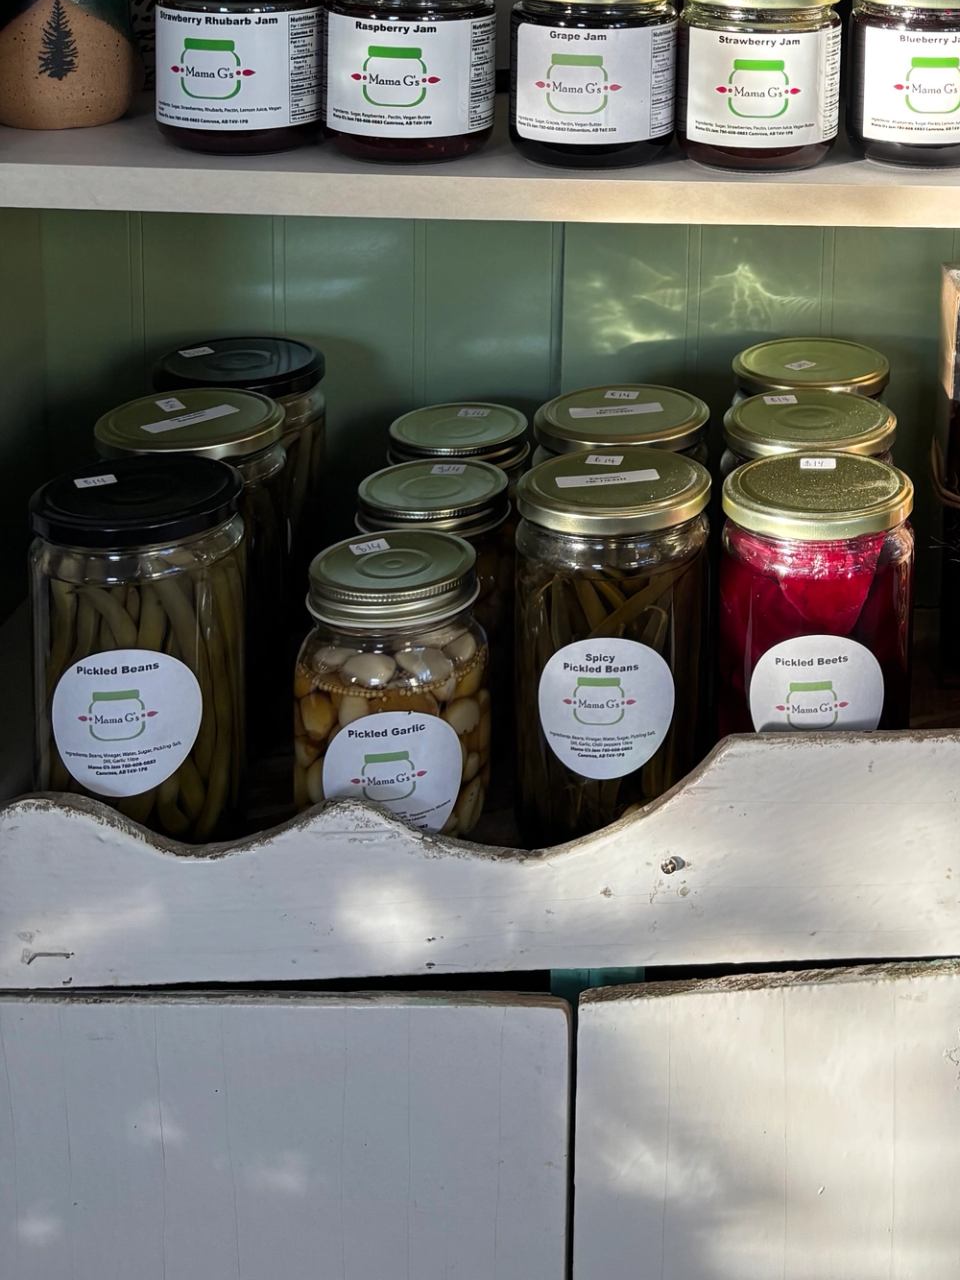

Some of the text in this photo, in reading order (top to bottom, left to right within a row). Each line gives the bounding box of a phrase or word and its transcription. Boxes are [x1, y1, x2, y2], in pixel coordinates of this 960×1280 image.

[160, 10, 279, 26] Strawberry Rhubarb Jam
[355, 21, 437, 35] Raspberry Jam
[549, 31, 607, 41] Grape Jam
[718, 35, 801, 47] Strawberry Jam
[900, 34, 949, 46] Blueberry
[585, 653, 616, 664] Spicy
[775, 655, 849, 666] Pickled Beets
[76, 662, 160, 675] Pickled Beans
[563, 663, 639, 672] Pickled Beans
[347, 723, 426, 738] Pickled Garlic
